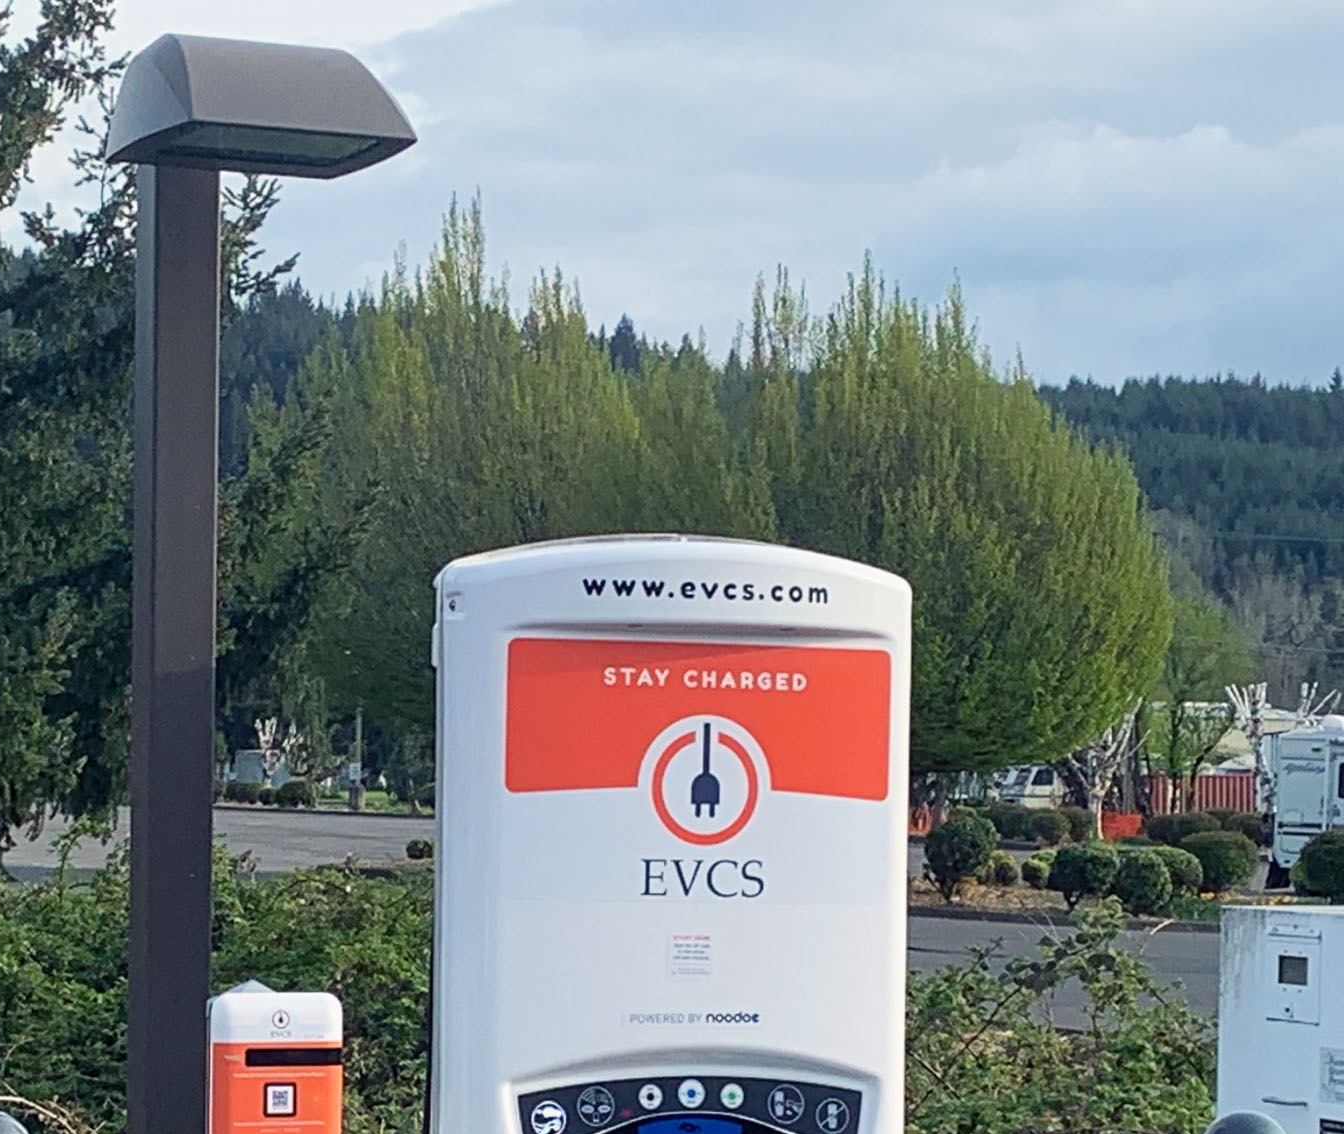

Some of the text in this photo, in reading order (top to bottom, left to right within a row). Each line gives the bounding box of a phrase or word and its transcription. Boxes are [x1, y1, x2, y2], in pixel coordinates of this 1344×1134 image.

[583, 578, 829, 604] www.evcs.com
[603, 666, 808, 691] STAY CHARGED
[641, 858, 765, 898] EVCS
[629, 1011, 760, 1024] POWERED BY noodoe
